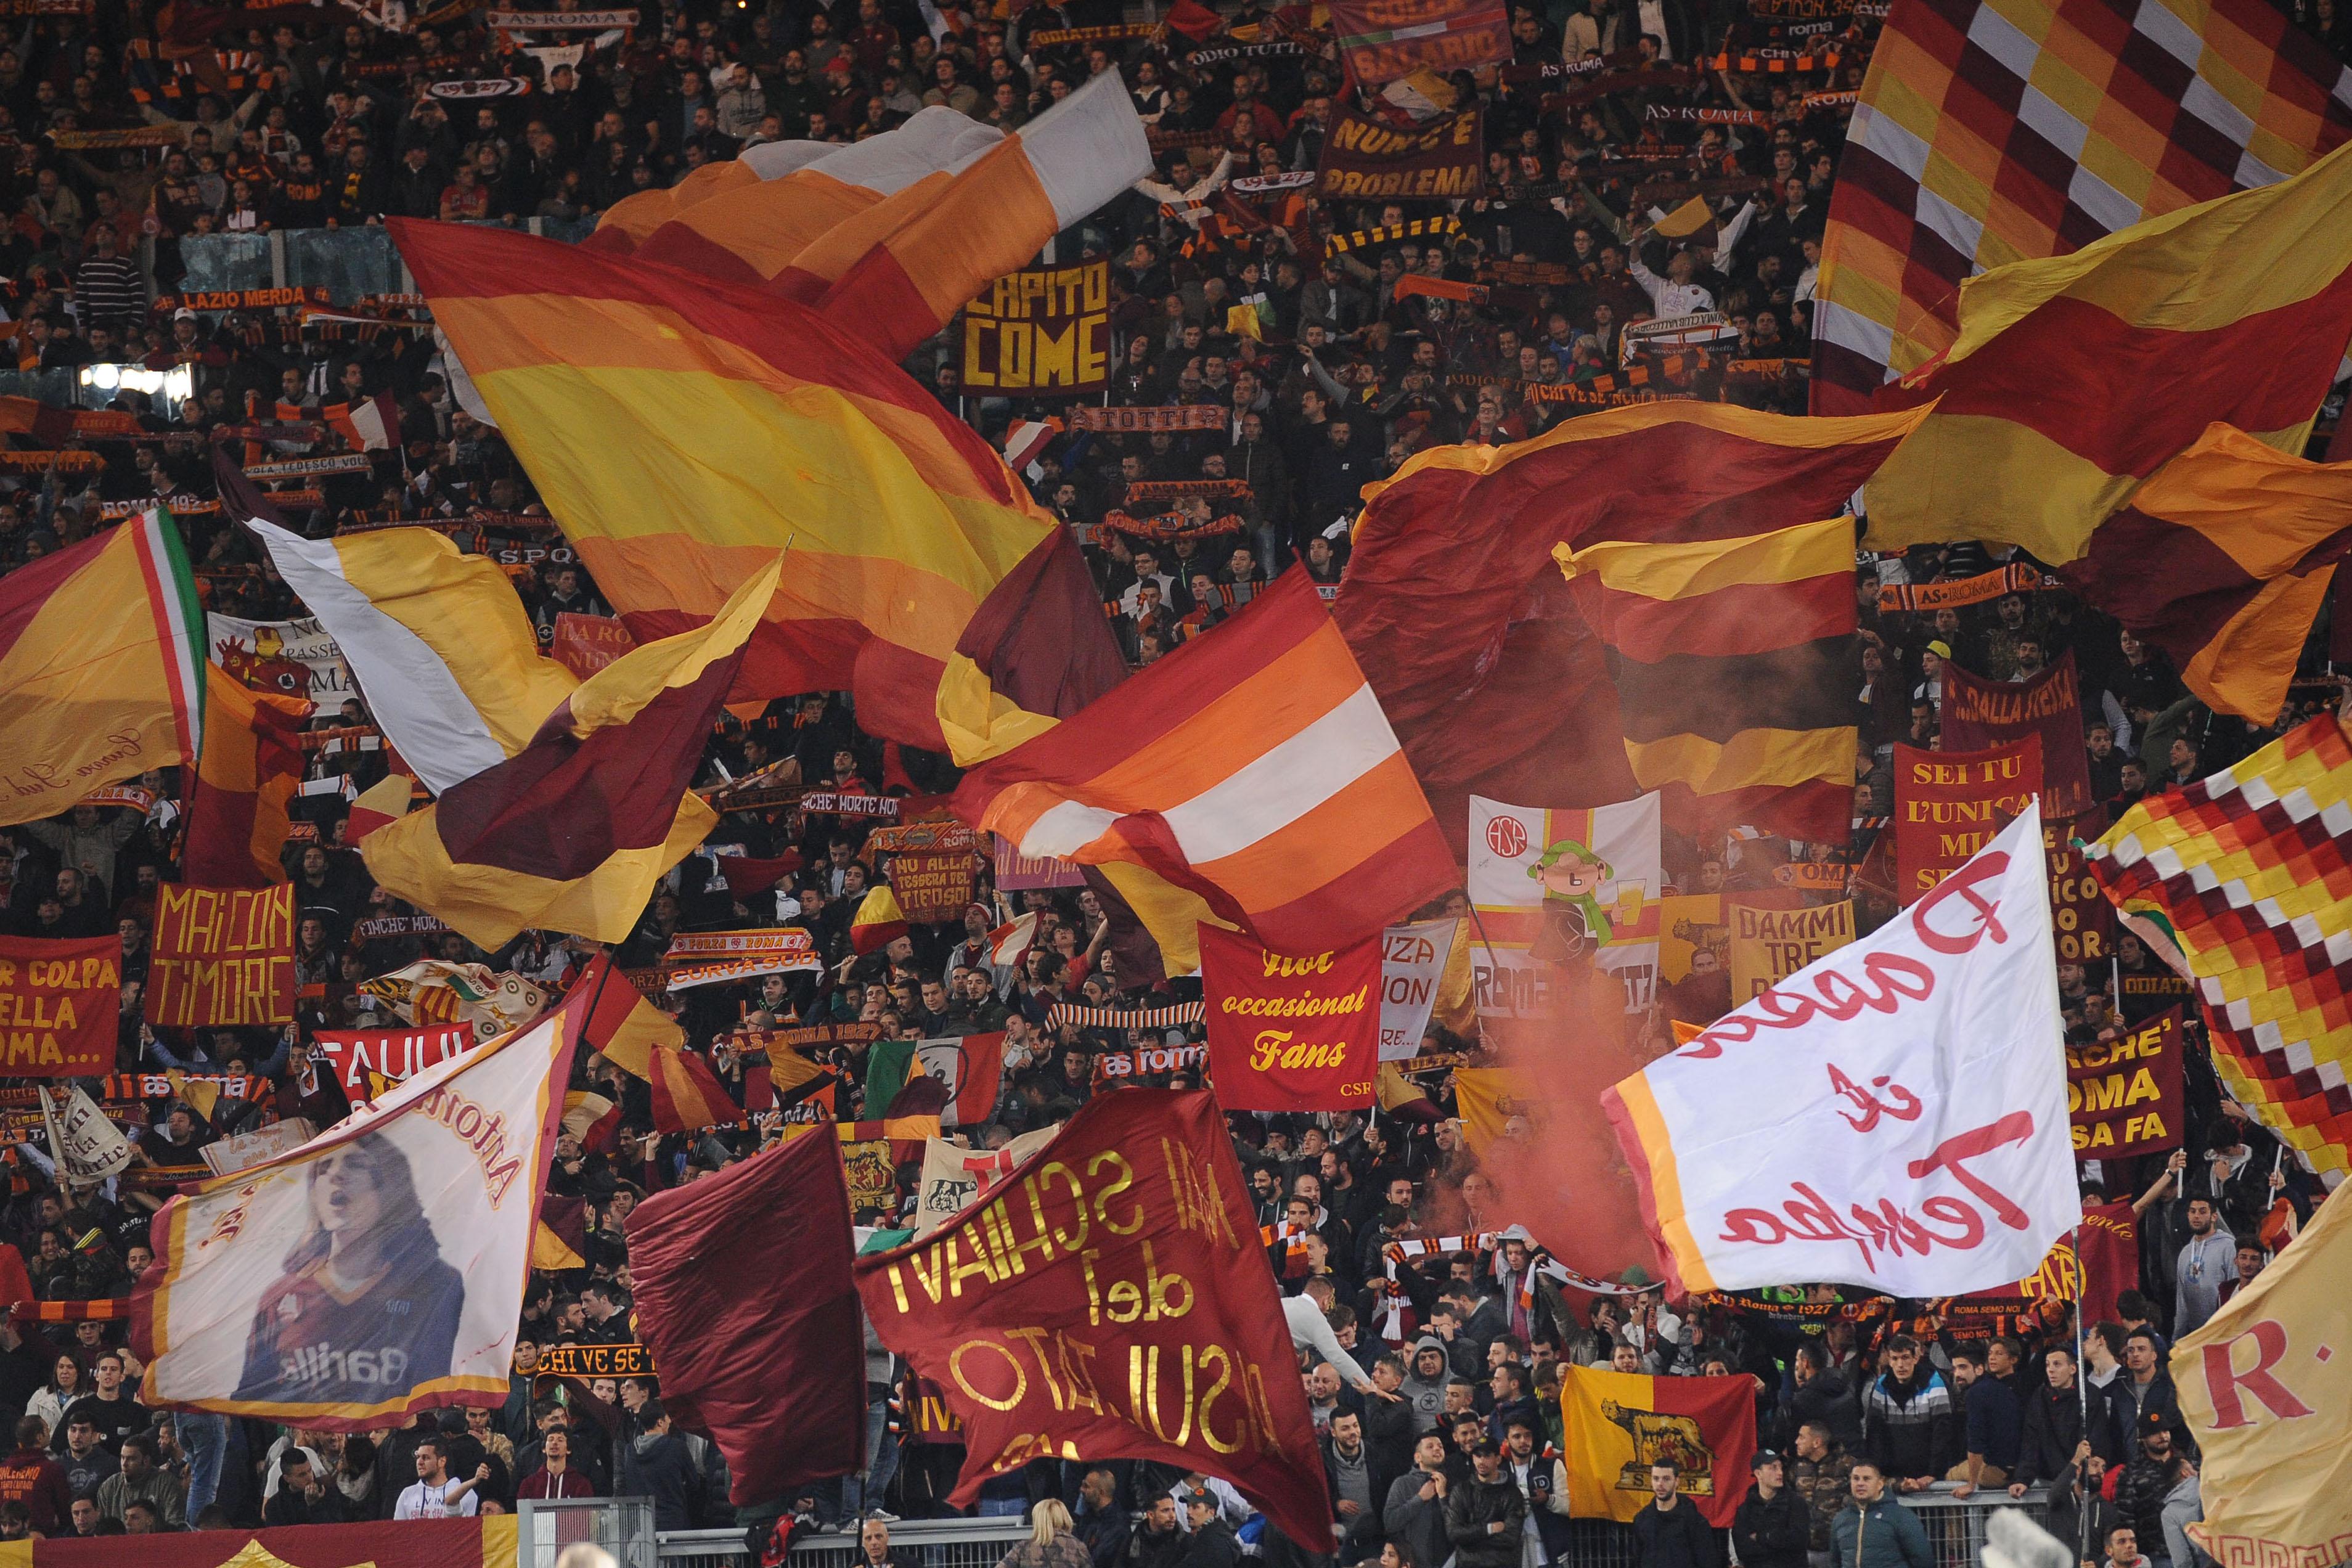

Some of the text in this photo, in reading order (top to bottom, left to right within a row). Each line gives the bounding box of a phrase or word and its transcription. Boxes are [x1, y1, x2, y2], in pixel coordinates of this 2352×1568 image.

[510, 13, 617, 24] AS ROMA
[1789, 21, 1833, 36] roma
[1038, 27, 1102, 44] ODIATI
[1109, 25, 1121, 36] E
[1193, 47, 1238, 65] ODIO
[1760, 48, 1789, 59] CHI
[440, 83, 502, 95] 19 27
[1806, 91, 1857, 107] ROM
[1322, 164, 1479, 197] PROBLEMA
[184, 286, 306, 309] LAZIO MERDA
[1679, 316, 1699, 326] CLUB
[963, 313, 1108, 387] COME
[1100, 410, 1190, 428] TOTTI
[20, 452, 86, 473] ROMA
[280, 460, 336, 472] TEDESCO
[343, 457, 368, 467] VOL
[103, 497, 160, 517] ROMA
[500, 548, 582, 565] SPQ
[560, 623, 632, 644] LA RO
[1913, 755, 2022, 785] SEI TU
[839, 794, 877, 814] MORTE
[943, 836, 976, 849] ROMA
[1487, 817, 1532, 856] ASR
[927, 855, 973, 871] ALLA
[897, 872, 947, 889] TESSERA
[900, 887, 970, 910] TIFOSO!
[1739, 904, 1846, 939] DAMMI
[689, 936, 783, 950] FORZA ROMA
[1381, 936, 1435, 964] NZA
[670, 951, 816, 984] CURVA SUD
[1765, 941, 1823, 975] TRE
[0, 958, 120, 989] R COLPA
[628, 974, 667, 987] ORZA
[1381, 975, 1432, 1005] ION
[0, 992, 78, 1030] ELLA
[1223, 984, 1367, 1018] occasional
[773, 1025, 831, 1045] ROMA
[836, 1022, 883, 1040] 1927
[1381, 1029, 1414, 1046] RE...
[2067, 1018, 2172, 1069] RCHE'
[1250, 1030, 1345, 1072] Fans
[1103, 1054, 1132, 1076] as
[143, 1076, 247, 1097] as ma
[753, 1102, 818, 1127] RMA
[2071, 1111, 2168, 1151] SA FA
[2083, 1214, 2134, 1241] ente
[1737, 1297, 1834, 1315] Roma 1927
[1954, 1305, 2021, 1314] ROMA SEMO NOI
[538, 1350, 578, 1373] CHI
[582, 1349, 609, 1373] VE
[615, 1347, 641, 1372] SE
